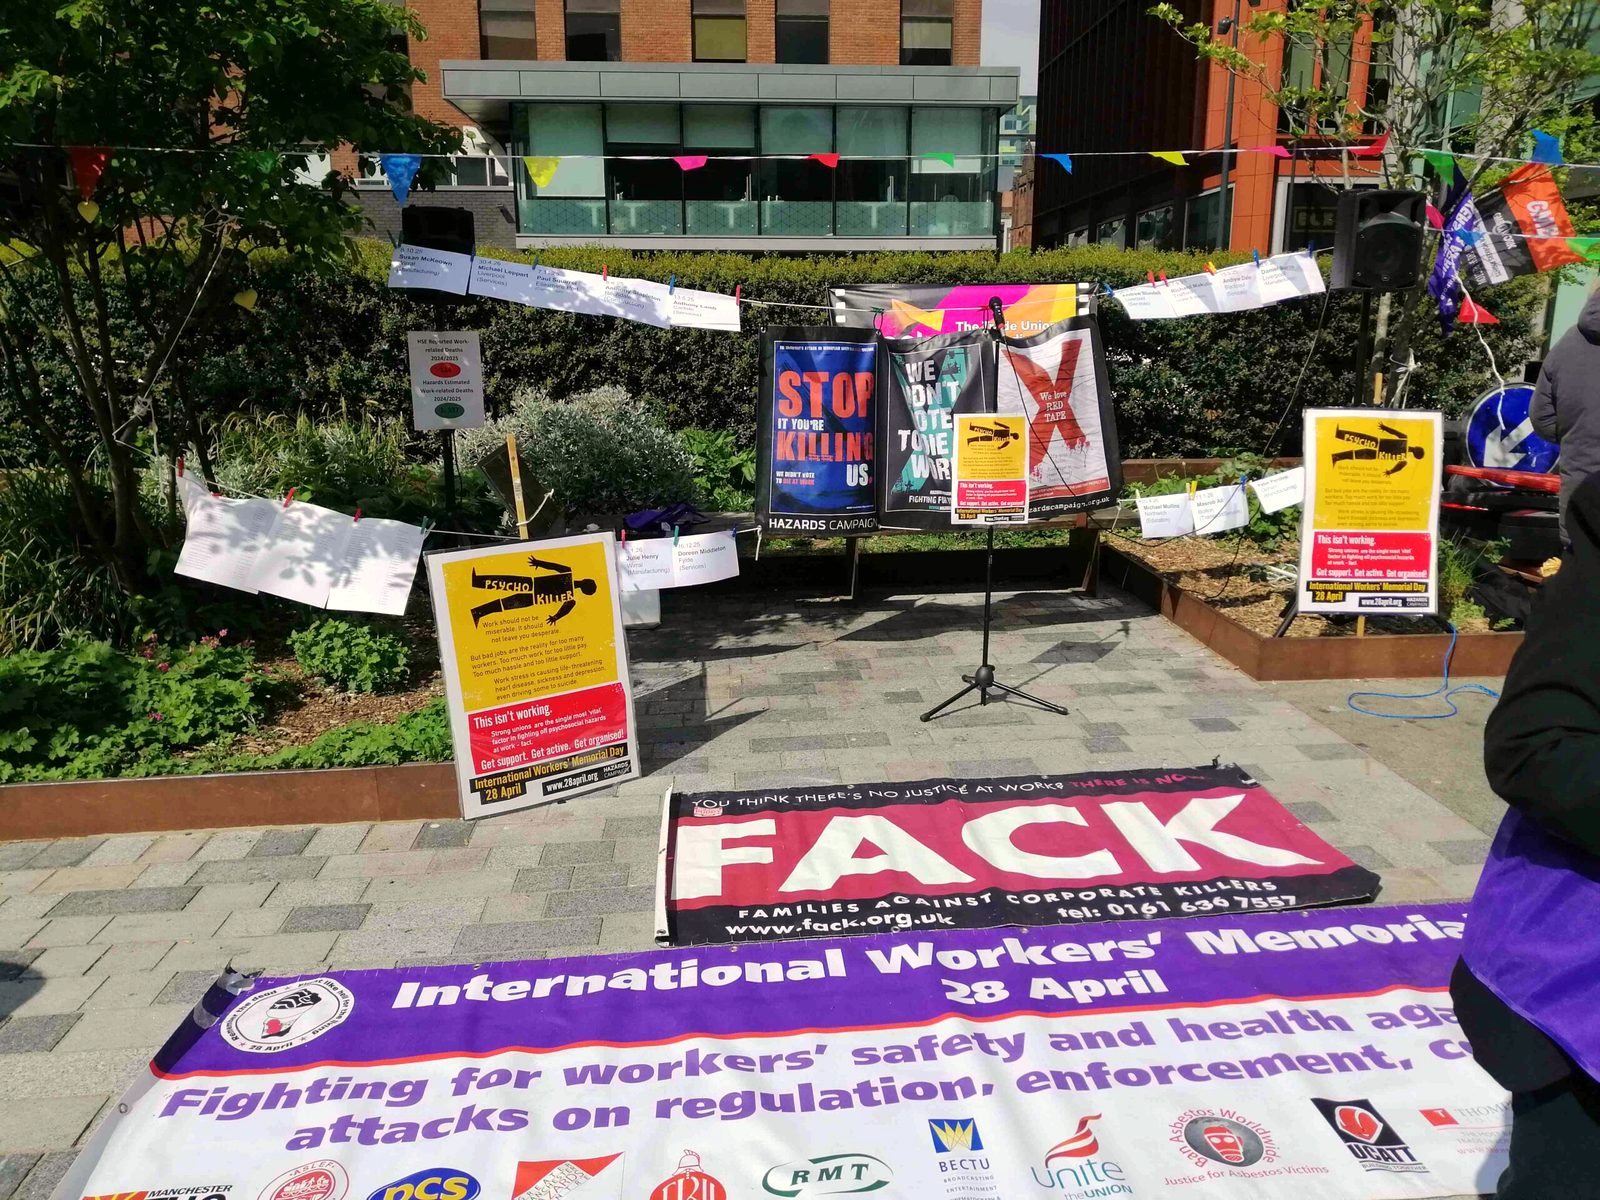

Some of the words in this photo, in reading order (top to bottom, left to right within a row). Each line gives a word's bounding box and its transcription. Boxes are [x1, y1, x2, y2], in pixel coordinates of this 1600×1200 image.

[477, 271, 506, 280] Liverpool
[478, 265, 503, 273] Michael
[955, 321, 979, 331] The
[905, 360, 936, 384] WE
[778, 370, 874, 419] STOP
[1040, 392, 1052, 401] We
[1054, 391, 1067, 400] love
[1046, 401, 1064, 411] RED
[1044, 411, 1067, 422] TAPE
[791, 419, 824, 431] YOU'RE
[776, 431, 873, 462] KILLING
[898, 429, 922, 452] TO
[1344, 434, 1376, 448] PSYCHO
[1379, 451, 1407, 461] KILLER
[909, 495, 937, 504] FIGHTING
[769, 518, 826, 530] HAZARDS
[829, 517, 878, 530] CAMPAIGN
[1317, 535, 1332, 544] This
[1332, 535, 1349, 544] isn't
[1349, 536, 1376, 547] working.
[626, 553, 641, 561] Julie
[641, 553, 660, 561] Henry
[678, 550, 699, 558] Doreen
[699, 545, 727, 555] Middleton
[679, 563, 707, 572] (Services)
[485, 580, 530, 591] PSYCHO
[1309, 582, 1353, 591] International
[1354, 582, 1382, 591] Workers'
[1382, 582, 1413, 591] Memorial
[1413, 583, 1426, 593] Day
[536, 591, 574, 604] KILLER
[1315, 592, 1325, 600] 28
[1326, 592, 1343, 602] April
[1361, 598, 1403, 607] www.28april.org
[482, 621, 499, 629] Work
[500, 617, 520, 626] should
[485, 627, 519, 636] miserable.
[524, 622, 544, 630] should
[502, 635, 518, 643] leave
[519, 634, 530, 642] you
[531, 628, 562, 639] desperate.
[474, 716, 494, 730] This
[494, 711, 515, 725] isn't
[516, 704, 553, 721] working.
[481, 760, 496, 771] Get
[496, 753, 529, 767] support.
[531, 748, 545, 758] Get
[546, 743, 572, 755] active.
[574, 738, 588, 749] Get
[588, 729, 625, 747] organised!
[474, 768, 532, 790] International
[532, 757, 571, 777] Workers'
[571, 748, 609, 767] Memorial
[609, 745, 625, 759] Day
[603, 761, 629, 773] HAZARDS
[546, 771, 599, 792] www.28april.org
[485, 787, 498, 801] 28
[500, 781, 522, 799] April
[692, 799, 730, 808] YOU
[737, 794, 790, 807] THINK
[796, 791, 863, 803] THERE'S
[869, 790, 899, 798] NO
[905, 783, 969, 798] JUSTICE
[976, 784, 996, 793] AT
[999, 781, 1064, 793] WORK?
[1069, 779, 1127, 789] THERE
[1133, 777, 1150, 785] IS
[670, 793, 1325, 900] FACK
[737, 900, 861, 918] FAMILIES
[874, 892, 993, 910] AGAINST
[1005, 883, 1161, 905] CORPORATE
[1172, 881, 1278, 896] KILLERS
[1057, 905, 1101, 921] tel:
[1107, 900, 1171, 915] 0161
[1180, 898, 1230, 912] 636
[1233, 895, 1296, 908] 7557
[725, 912, 956, 936] www.fack.org.uk
[391, 948, 847, 1009] International
[865, 931, 1164, 975] Workers'
[1185, 913, 1467, 955] Memoria
[323, 979, 340, 991] like
[941, 978, 1009, 1005] 28
[1030, 969, 1170, 1005] April
[264, 1041, 295, 1051] April
[159, 1076, 430, 1119] Fighting
[450, 1065, 543, 1097] for
[562, 1044, 829, 1089] workers'
[850, 1028, 1028, 1065] safety
[1047, 1016, 1157, 1052] and
[1173, 1004, 1354, 1044] health
[283, 1104, 530, 1151] attacks
[551, 1106, 631, 1132] on
[654, 1074, 995, 1124] regulation,
[1016, 1041, 1414, 1096] enforcement,
[1432, 1108, 1446, 1118] T
[1168, 1108, 1216, 1143] Asbestos
[1220, 1107, 1281, 1164] Worldwide
[1179, 1144, 1209, 1168] Ban
[1346, 1143, 1418, 1163] UCATT
[293, 1161, 335, 1176] ASLEF
[938, 1158, 991, 1173] BECTU
[1361, 1162, 1392, 1171] BUILDING
[1392, 1164, 1427, 1172] TOGETHER
[791, 1163, 871, 1185] RMT
[943, 1174, 995, 1184] BROADCASTING
[1029, 1158, 1126, 1190] unite
[1164, 1174, 1207, 1186] Justice
[1207, 1169, 1226, 1181] for
[1228, 1166, 1283, 1180] Asbestos
[1283, 1164, 1330, 1176] Victims
[146, 1184, 234, 1198] MANCHESTER
[379, 1174, 470, 1200] pcs
[946, 1184, 998, 1194] ENTERTAINMENT
